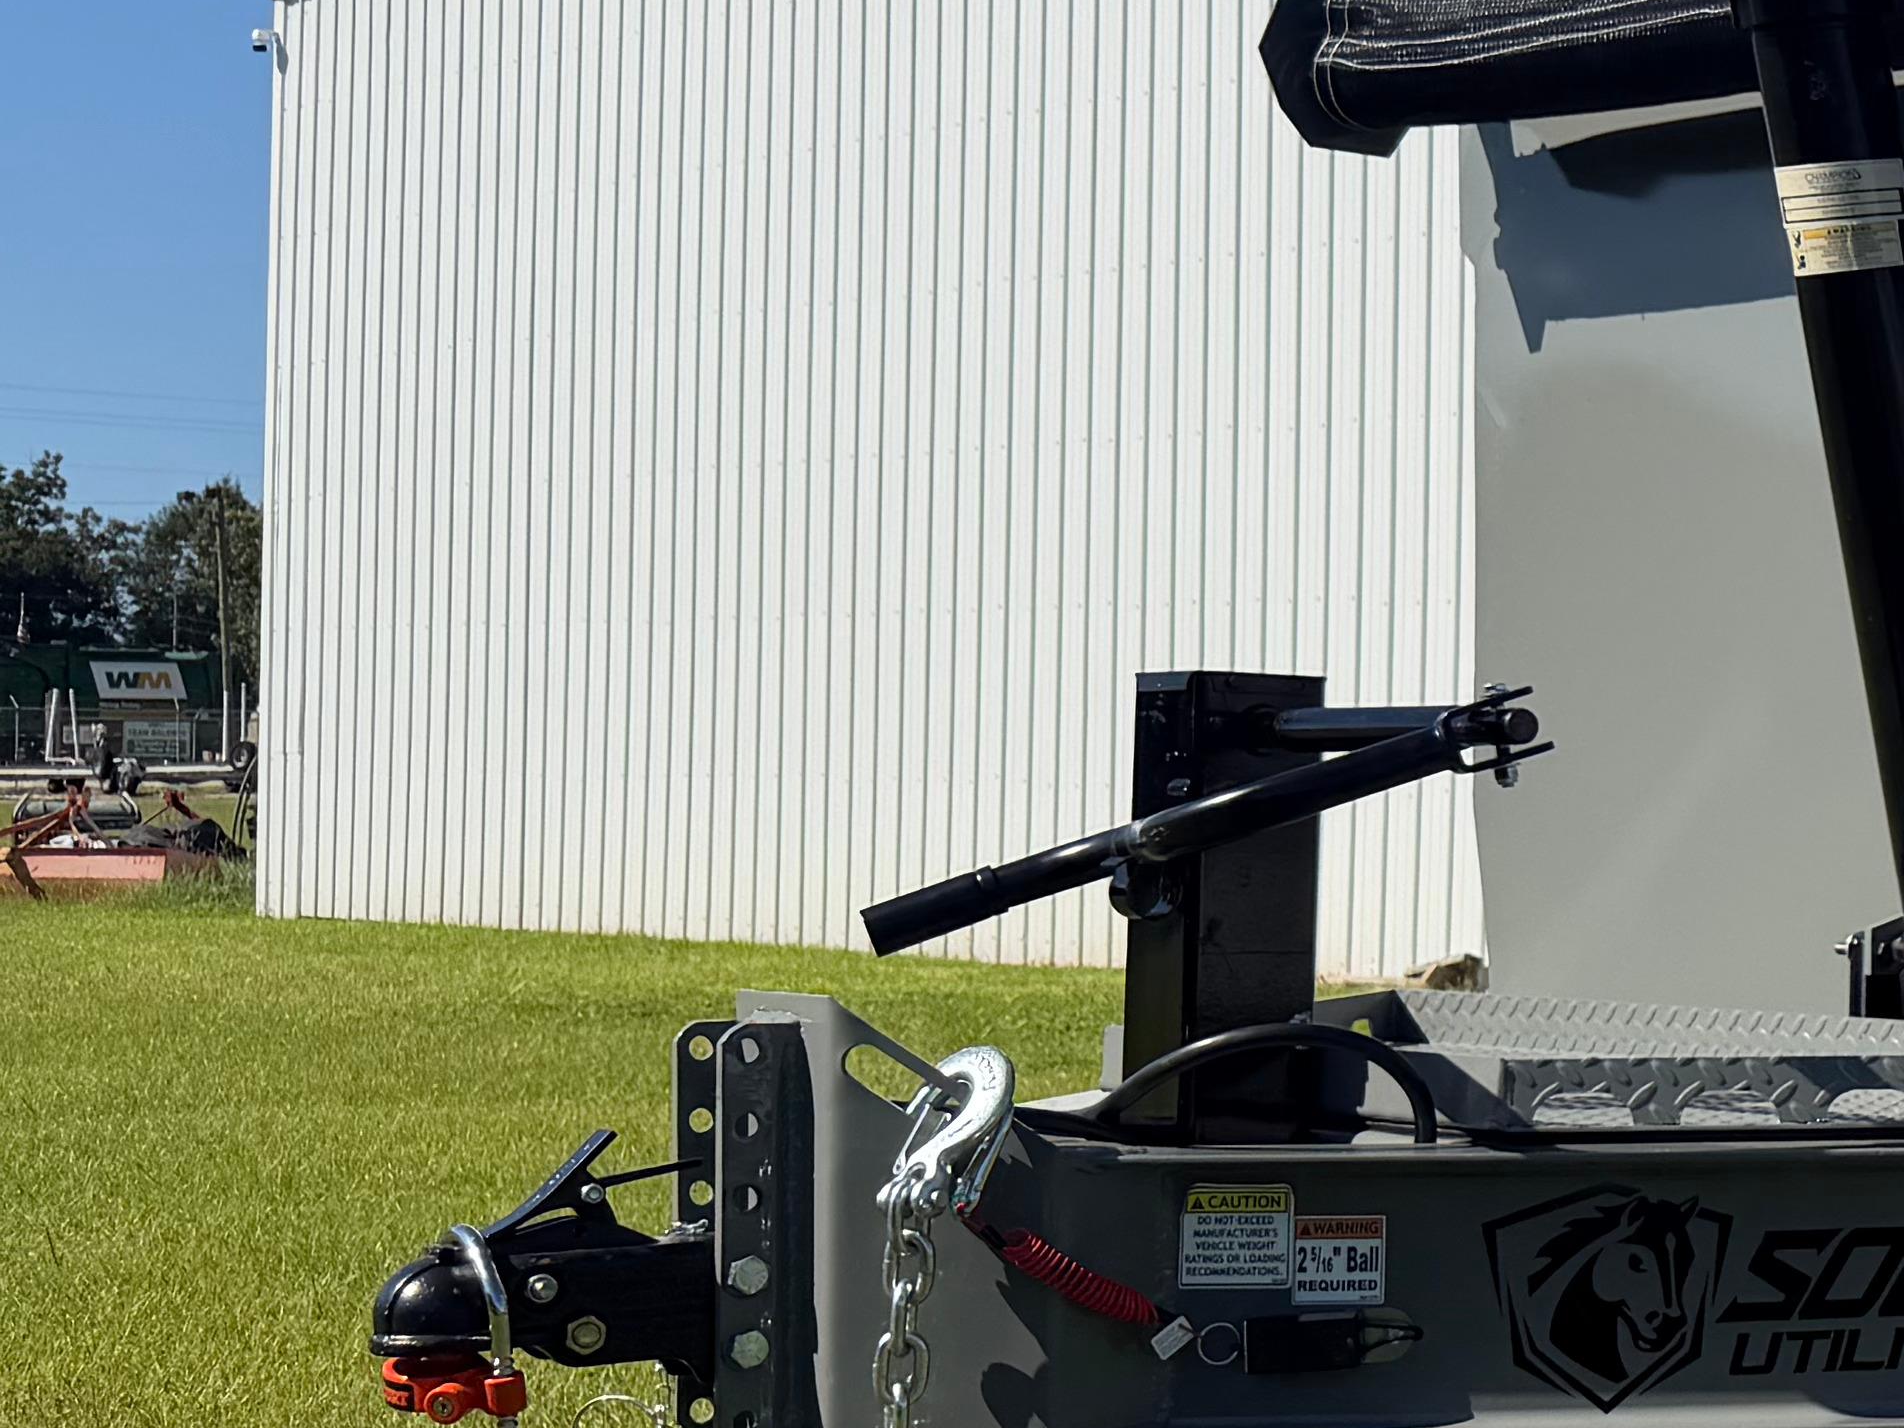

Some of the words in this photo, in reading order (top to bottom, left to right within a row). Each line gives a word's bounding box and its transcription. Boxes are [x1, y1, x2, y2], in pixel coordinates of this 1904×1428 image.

[105, 671, 172, 689] WM
[1208, 1195, 1282, 1208] CAUTION
[1197, 1215, 1212, 1225] DO
[1214, 1215, 1234, 1225] NOT
[1237, 1214, 1275, 1225] EXCEED
[1313, 1221, 1379, 1234] WARNING
[1195, 1240, 1235, 1251] VEHICLE
[1237, 1240, 1278, 1251] WEIGHT
[1184, 1253, 1225, 1264] RATINGS
[1226, 1253, 1241, 1264] OR
[1243, 1252, 1286, 1264] LOADING
[1297, 1246, 1307, 1273] 2
[1346, 1246, 1380, 1273] Ball
[1297, 1279, 1378, 1292] REQUIRED
